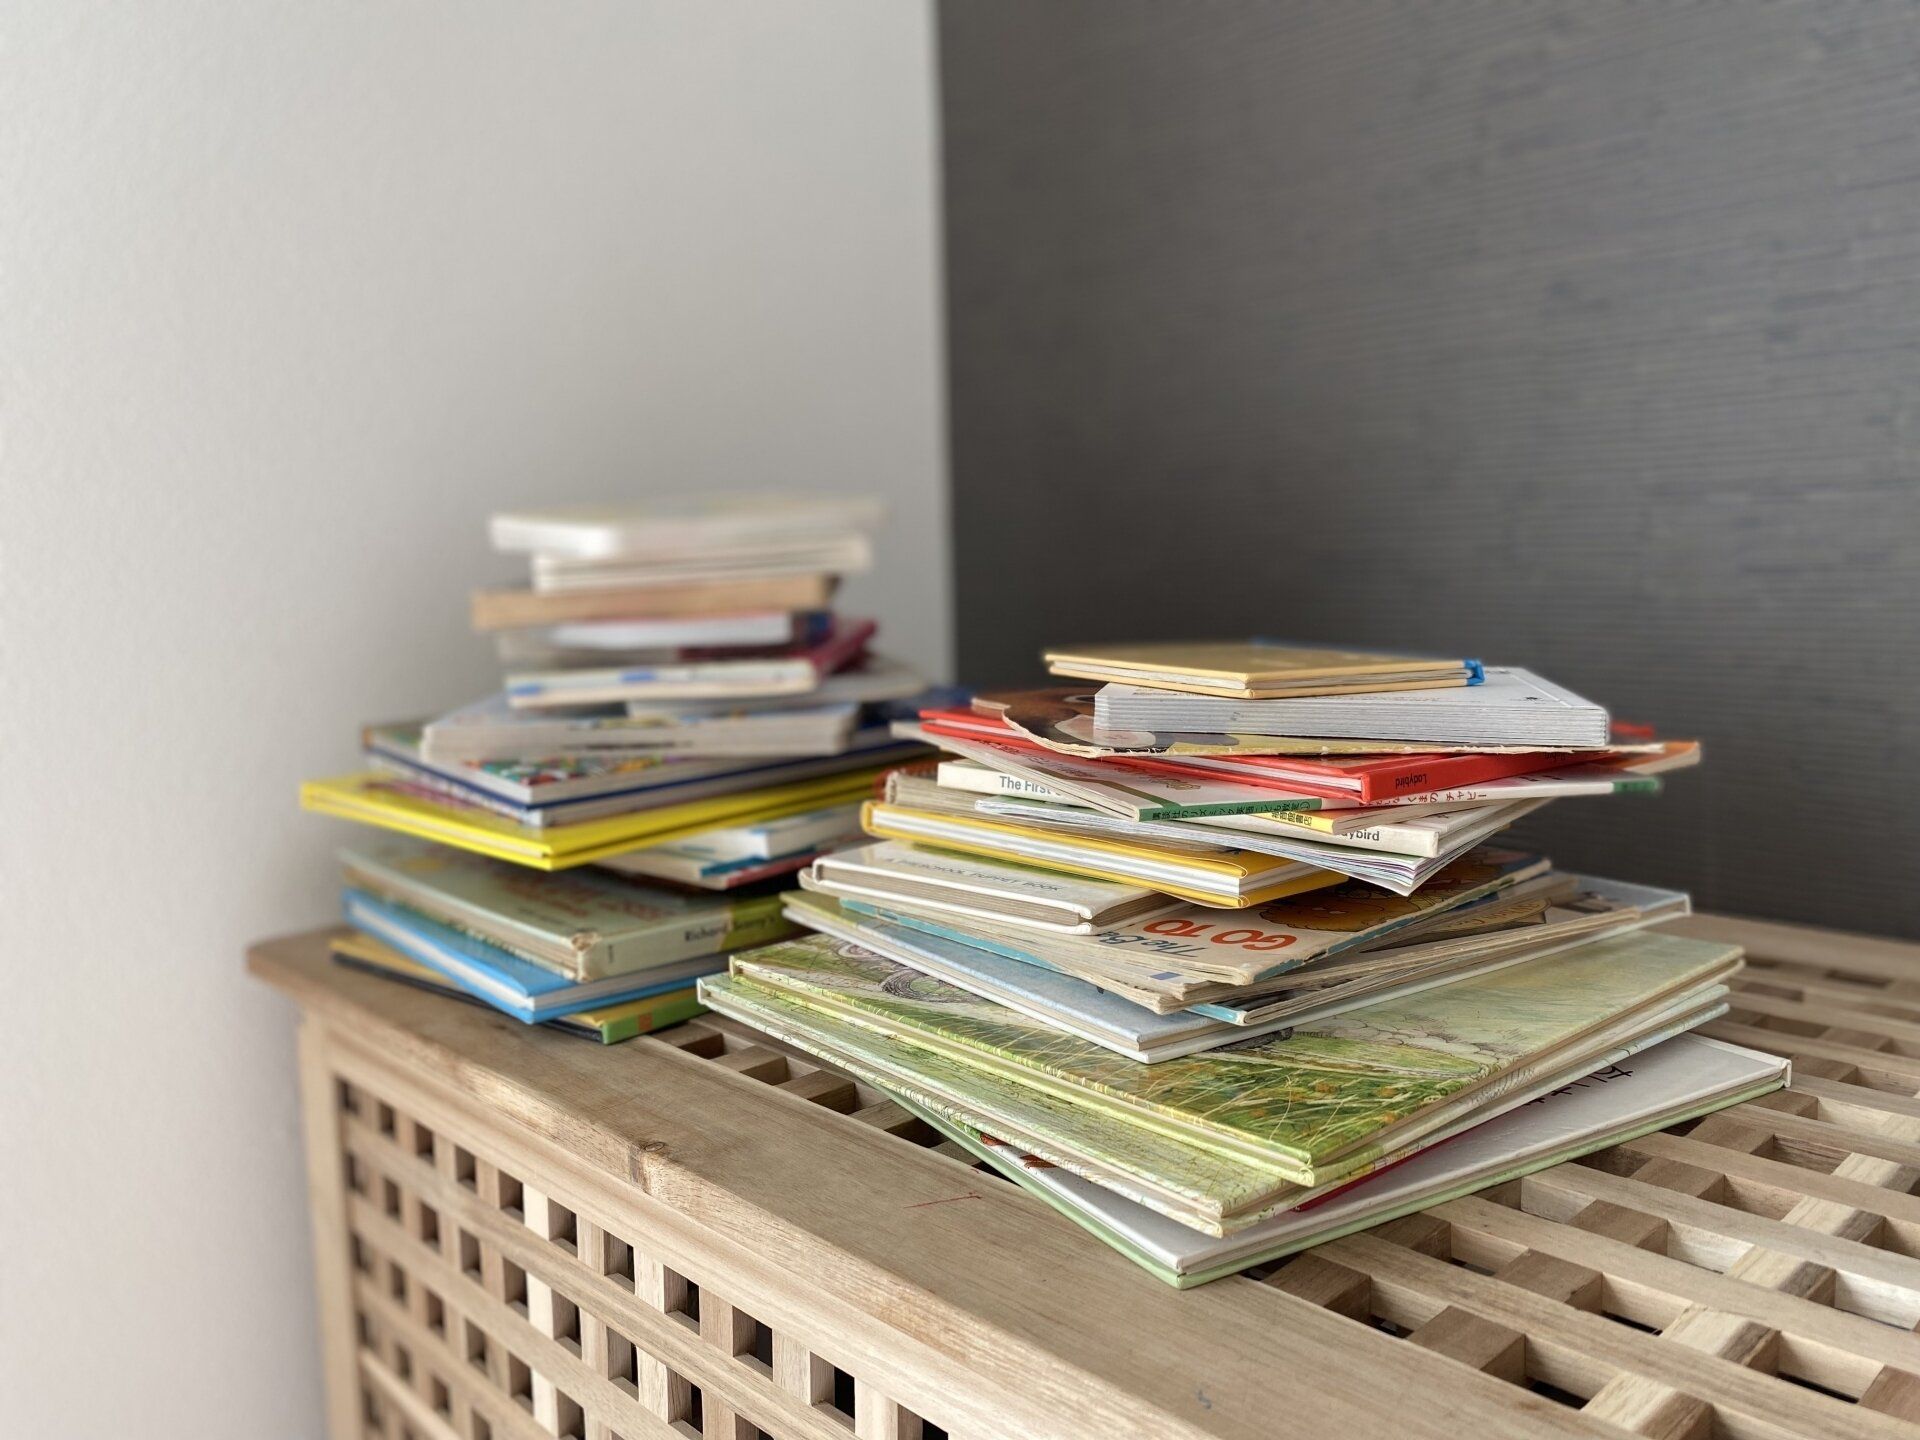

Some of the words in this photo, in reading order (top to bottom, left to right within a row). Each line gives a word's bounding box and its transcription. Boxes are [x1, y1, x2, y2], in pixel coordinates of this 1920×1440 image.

[999, 775, 1021, 790] The
[1395, 773, 1427, 789] Ladybird
[1142, 919, 1217, 938] TO
[1141, 939, 1208, 958] The
[1210, 929, 1298, 951] GO
